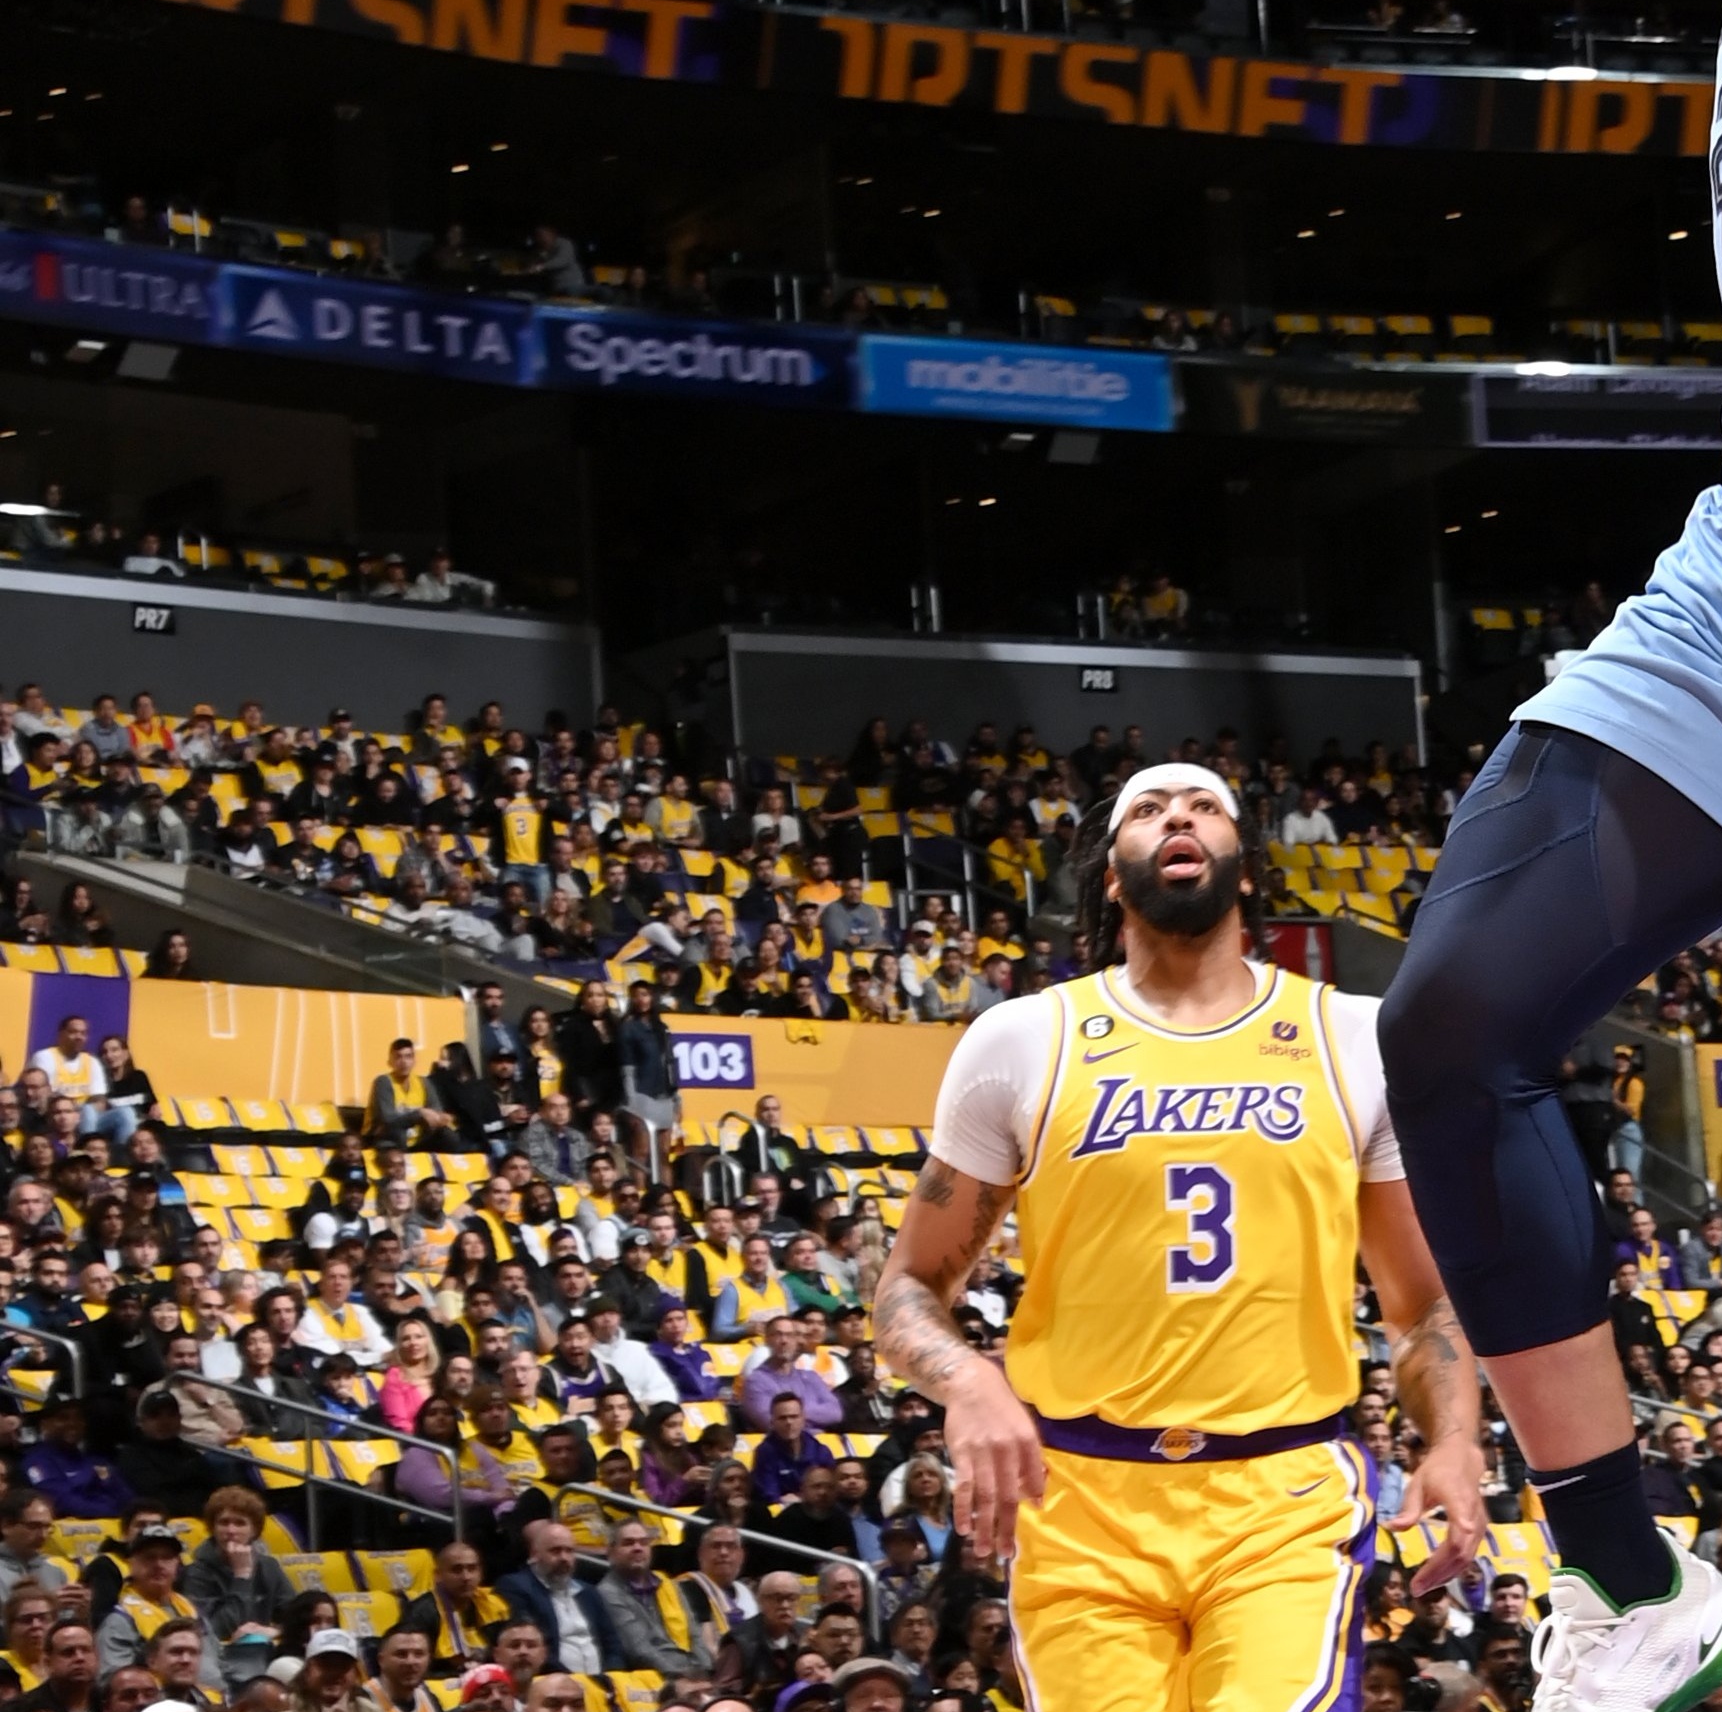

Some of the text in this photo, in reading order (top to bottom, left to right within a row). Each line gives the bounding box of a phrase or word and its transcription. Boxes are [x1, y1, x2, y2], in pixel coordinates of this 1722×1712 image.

[63, 262, 210, 320] ULTRA
[312, 298, 513, 365] DELTA
[564, 322, 816, 386] Spectrum
[134, 606, 171, 631] PR7
[673, 1040, 748, 1083] 103
[1258, 1042, 1312, 1061] bibigo
[1069, 1077, 1306, 1159] LAKERS
[1165, 1162, 1237, 1295] 3
